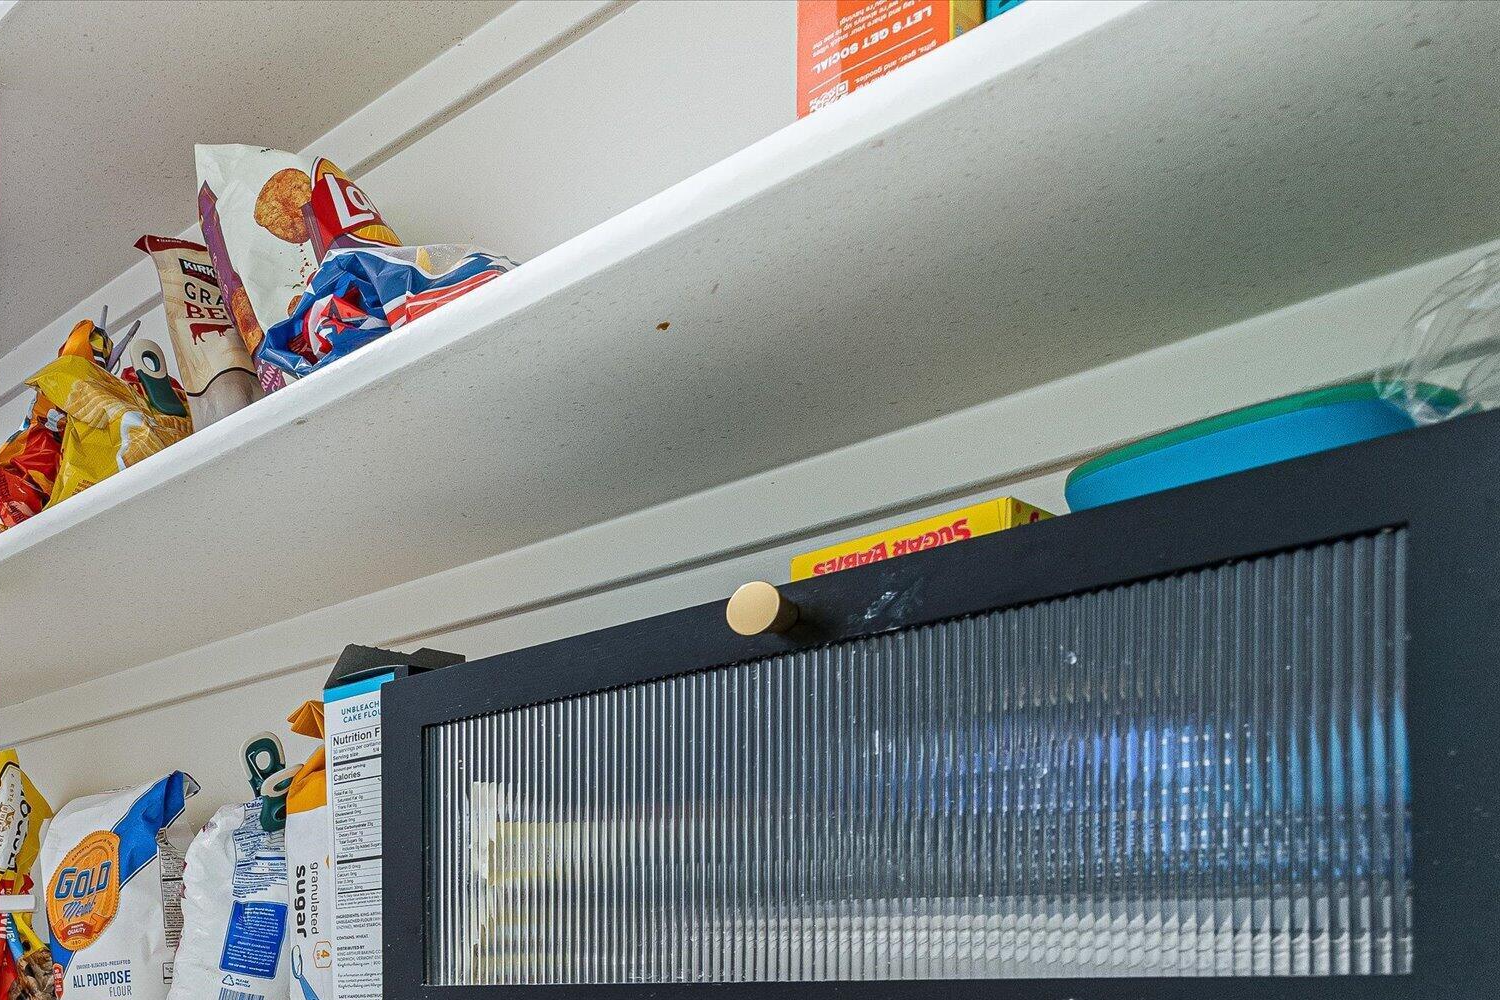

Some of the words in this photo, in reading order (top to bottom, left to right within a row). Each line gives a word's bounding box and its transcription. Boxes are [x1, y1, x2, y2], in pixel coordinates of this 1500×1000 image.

[892, 6, 932, 33] LET'S
[862, 28, 889, 48] GET
[813, 43, 858, 74] SOCIAL
[884, 60, 896, 69] and
[341, 701, 379, 715] UNBLEACH
[343, 715, 361, 723] CAKE
[333, 731, 371, 746] Nutrition
[333, 753, 349, 761] Serving
[334, 771, 360, 782] Calories
[55, 861, 112, 899] GOLD
[294, 865, 307, 938] sugar
[310, 862, 319, 935] granulated
[321, 950, 329, 958] 4
[73, 974, 85, 988] ALL
[87, 970, 131, 987] PURPOSE
[109, 986, 132, 997] FLOUR
